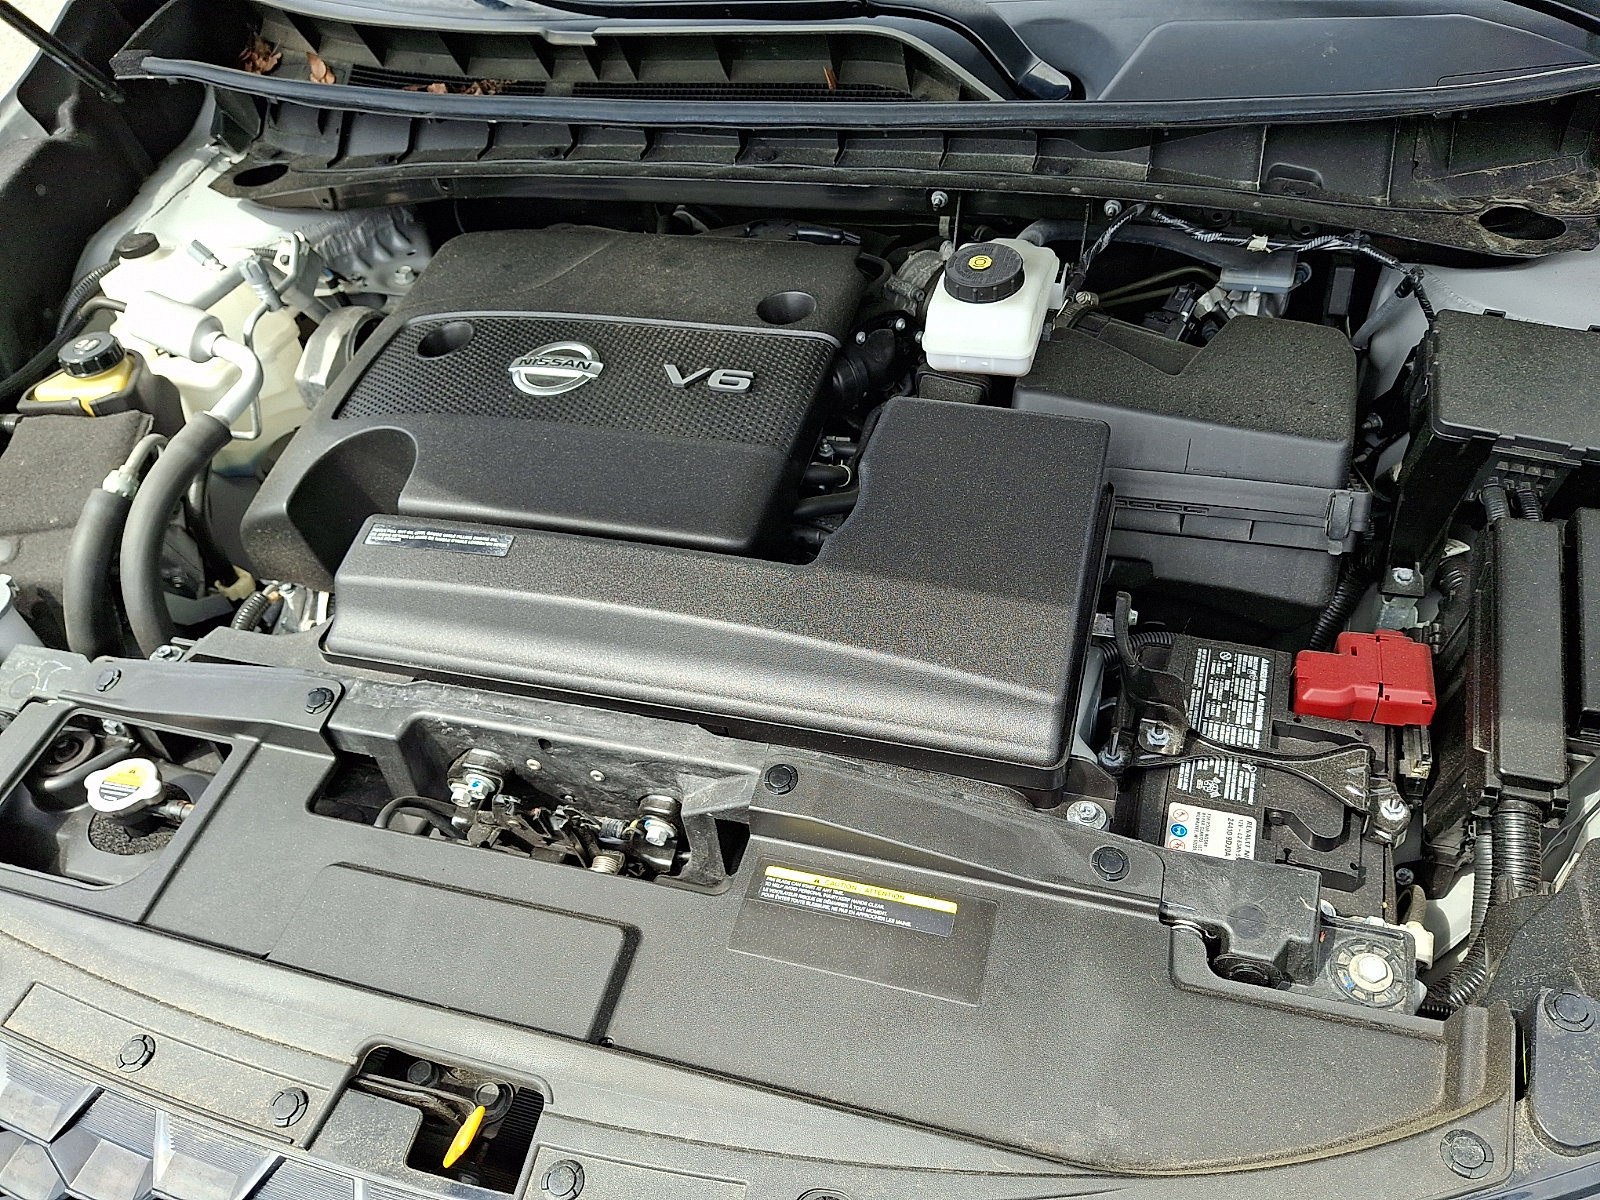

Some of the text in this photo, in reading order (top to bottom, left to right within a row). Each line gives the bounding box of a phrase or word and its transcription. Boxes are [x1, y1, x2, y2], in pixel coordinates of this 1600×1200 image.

[518, 356, 592, 370] NISSAN
[664, 363, 755, 393] V6
[1226, 817, 1235, 836] 24410
[1244, 820, 1253, 849] RENAULT
[825, 880, 857, 891] CAUTION
[865, 888, 905, 900] ATTENTION
